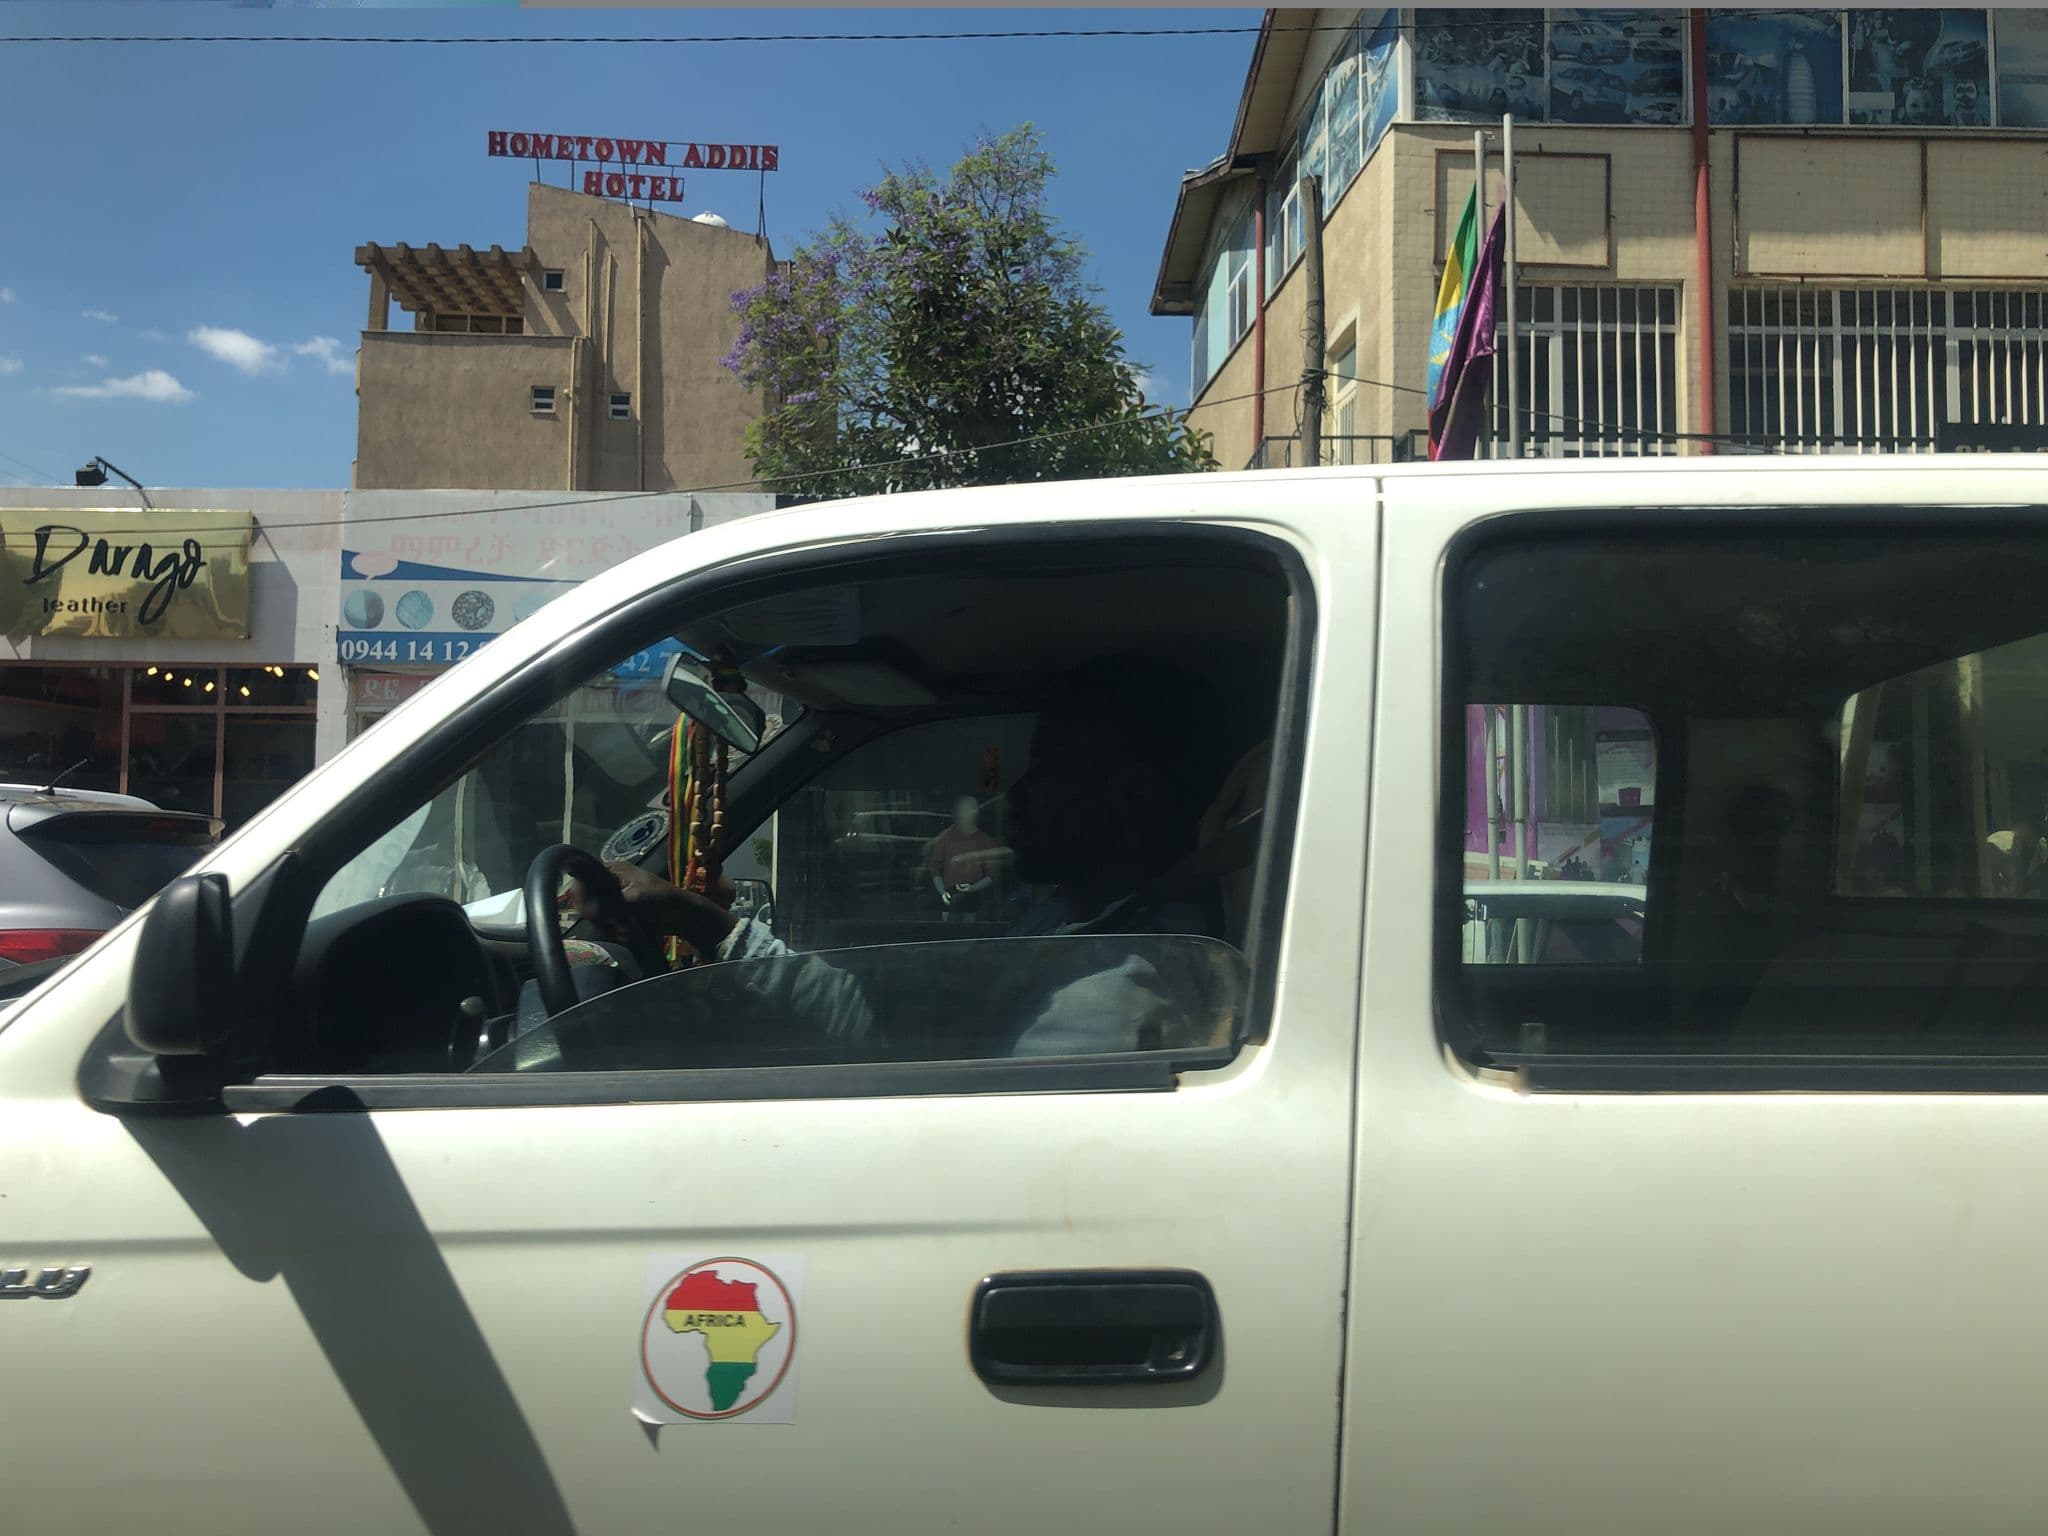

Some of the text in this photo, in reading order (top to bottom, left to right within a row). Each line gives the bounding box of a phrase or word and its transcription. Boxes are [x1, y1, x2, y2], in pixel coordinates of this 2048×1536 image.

[488, 131, 779, 172] HOMETOWN ADDIS
[584, 171, 685, 202] HOTEL
[43, 597, 129, 615] leather
[341, 639, 398, 661] 0944
[407, 640, 434, 661] 14
[443, 641, 470, 662] 12
[684, 1314, 746, 1327] AFRICA
